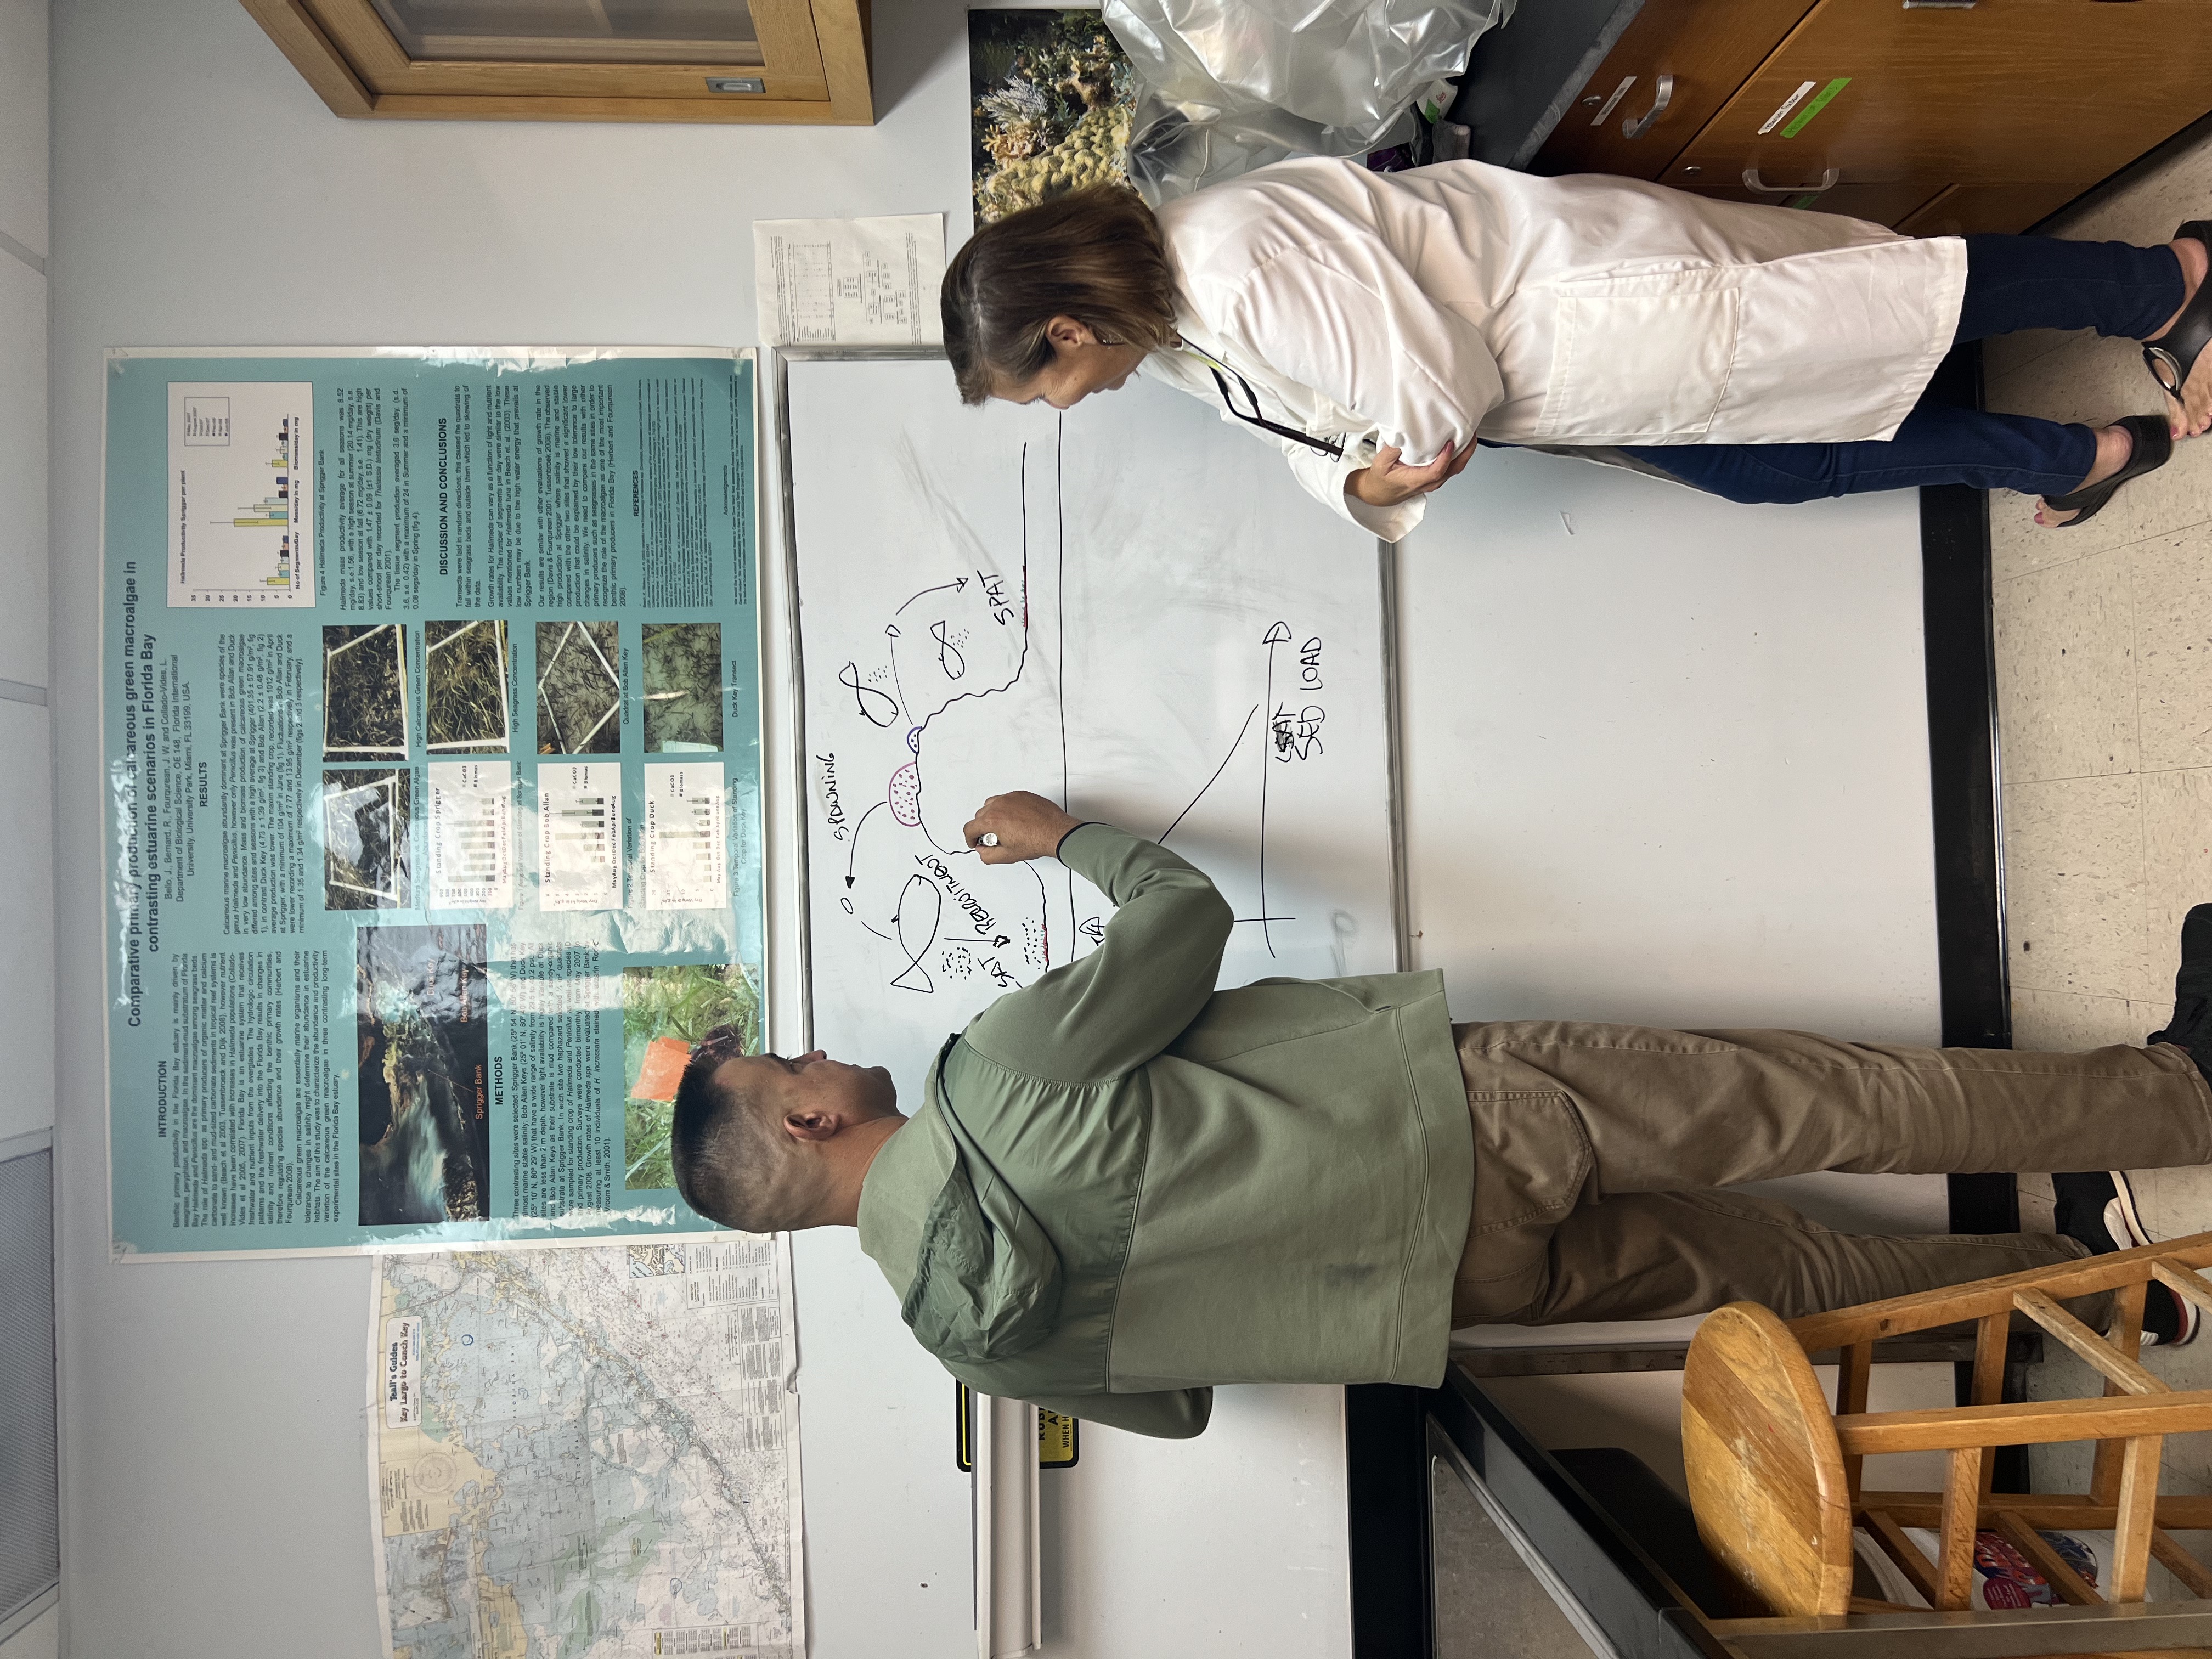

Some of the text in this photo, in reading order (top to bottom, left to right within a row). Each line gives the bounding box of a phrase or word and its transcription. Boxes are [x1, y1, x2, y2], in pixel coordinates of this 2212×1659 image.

[438, 418, 447, 489] CONCLUSIONS
[123, 561, 137, 573] in
[123, 578, 139, 657] macroalgae
[977, 569, 1014, 625] SPAT
[124, 661, 139, 700] green
[170, 655, 179, 702] International
[1295, 637, 1325, 760] SED LOAD
[161, 727, 170, 742] and
[172, 706, 180, 732] Florida
[184, 732, 191, 742] FL
[511, 719, 520, 733] High
[173, 757, 181, 769] OE
[199, 762, 207, 807] RESULTS
[125, 784, 137, 797] of
[140, 634, 161, 952] contrasting estuarine scenarios in Florida Bay
[221, 792, 229, 829] abundantly
[174, 808, 184, 844] Biological
[185, 795, 195, 833] University
[127, 803, 142, 877] production
[176, 857, 185, 902] Department
[128, 883, 142, 934] primary
[127, 940, 144, 1026] Comparative
[158, 1061, 167, 1137] INTRODUCTION
[475, 1086, 484, 1119] Sprigger
[494, 1057, 503, 1105] METHODS
[390, 1342, 398, 1372] Guides
[399, 1323, 409, 1422] Key Largo to Conch Key
